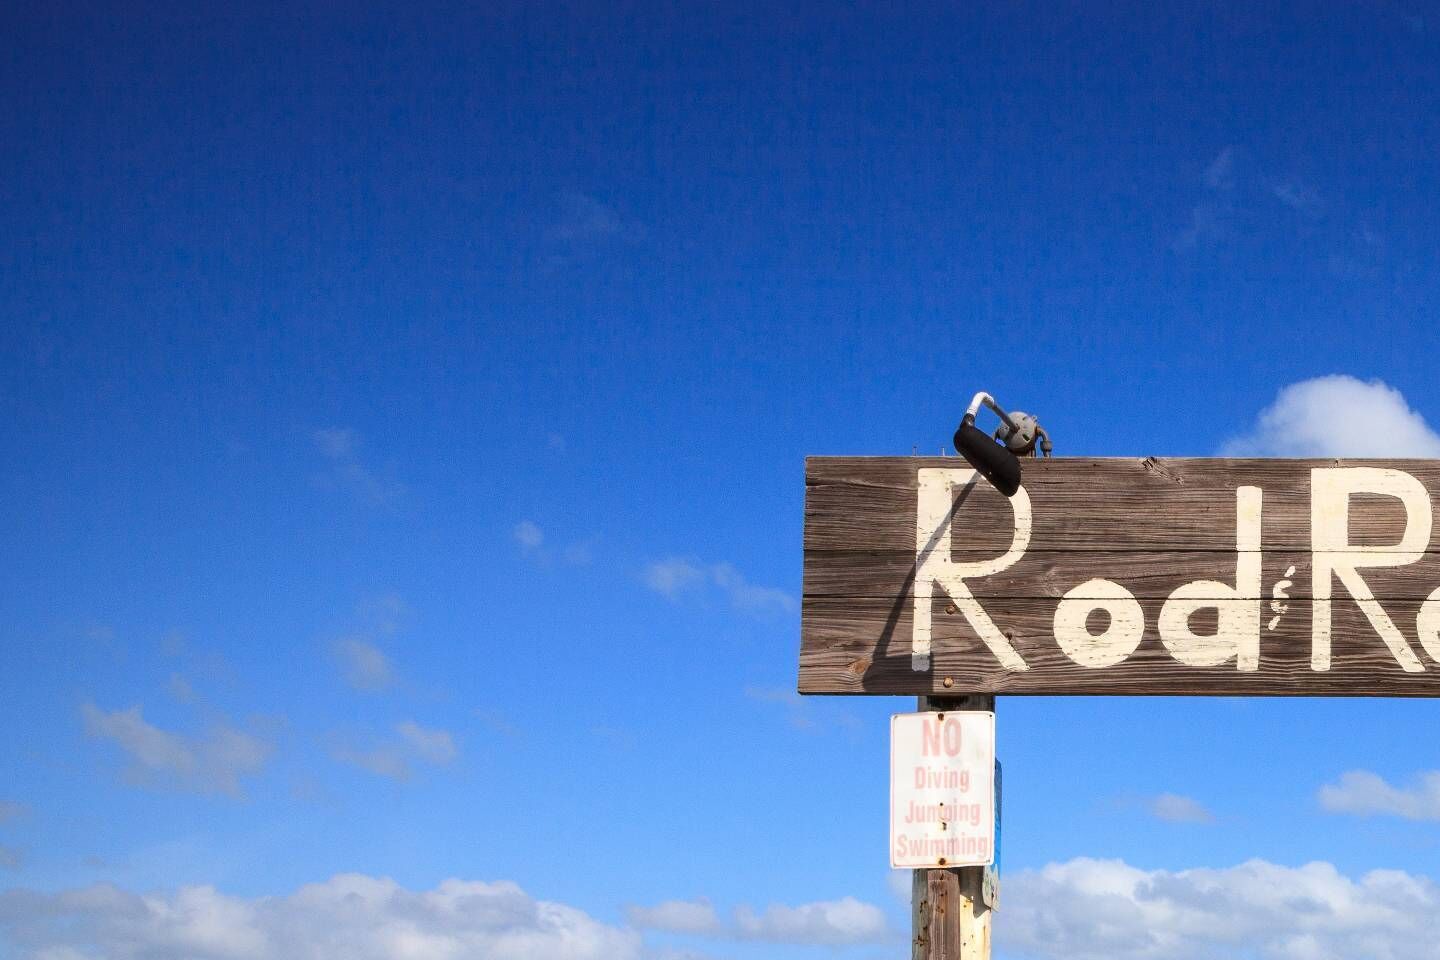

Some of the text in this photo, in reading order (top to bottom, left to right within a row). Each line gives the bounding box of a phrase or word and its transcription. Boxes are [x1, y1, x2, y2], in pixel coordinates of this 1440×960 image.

[912, 467, 1262, 672] Rod
[922, 717, 962, 758] NO
[914, 766, 970, 793] Diving
[905, 799, 981, 827] Jumping
[897, 832, 988, 858] Swimming
